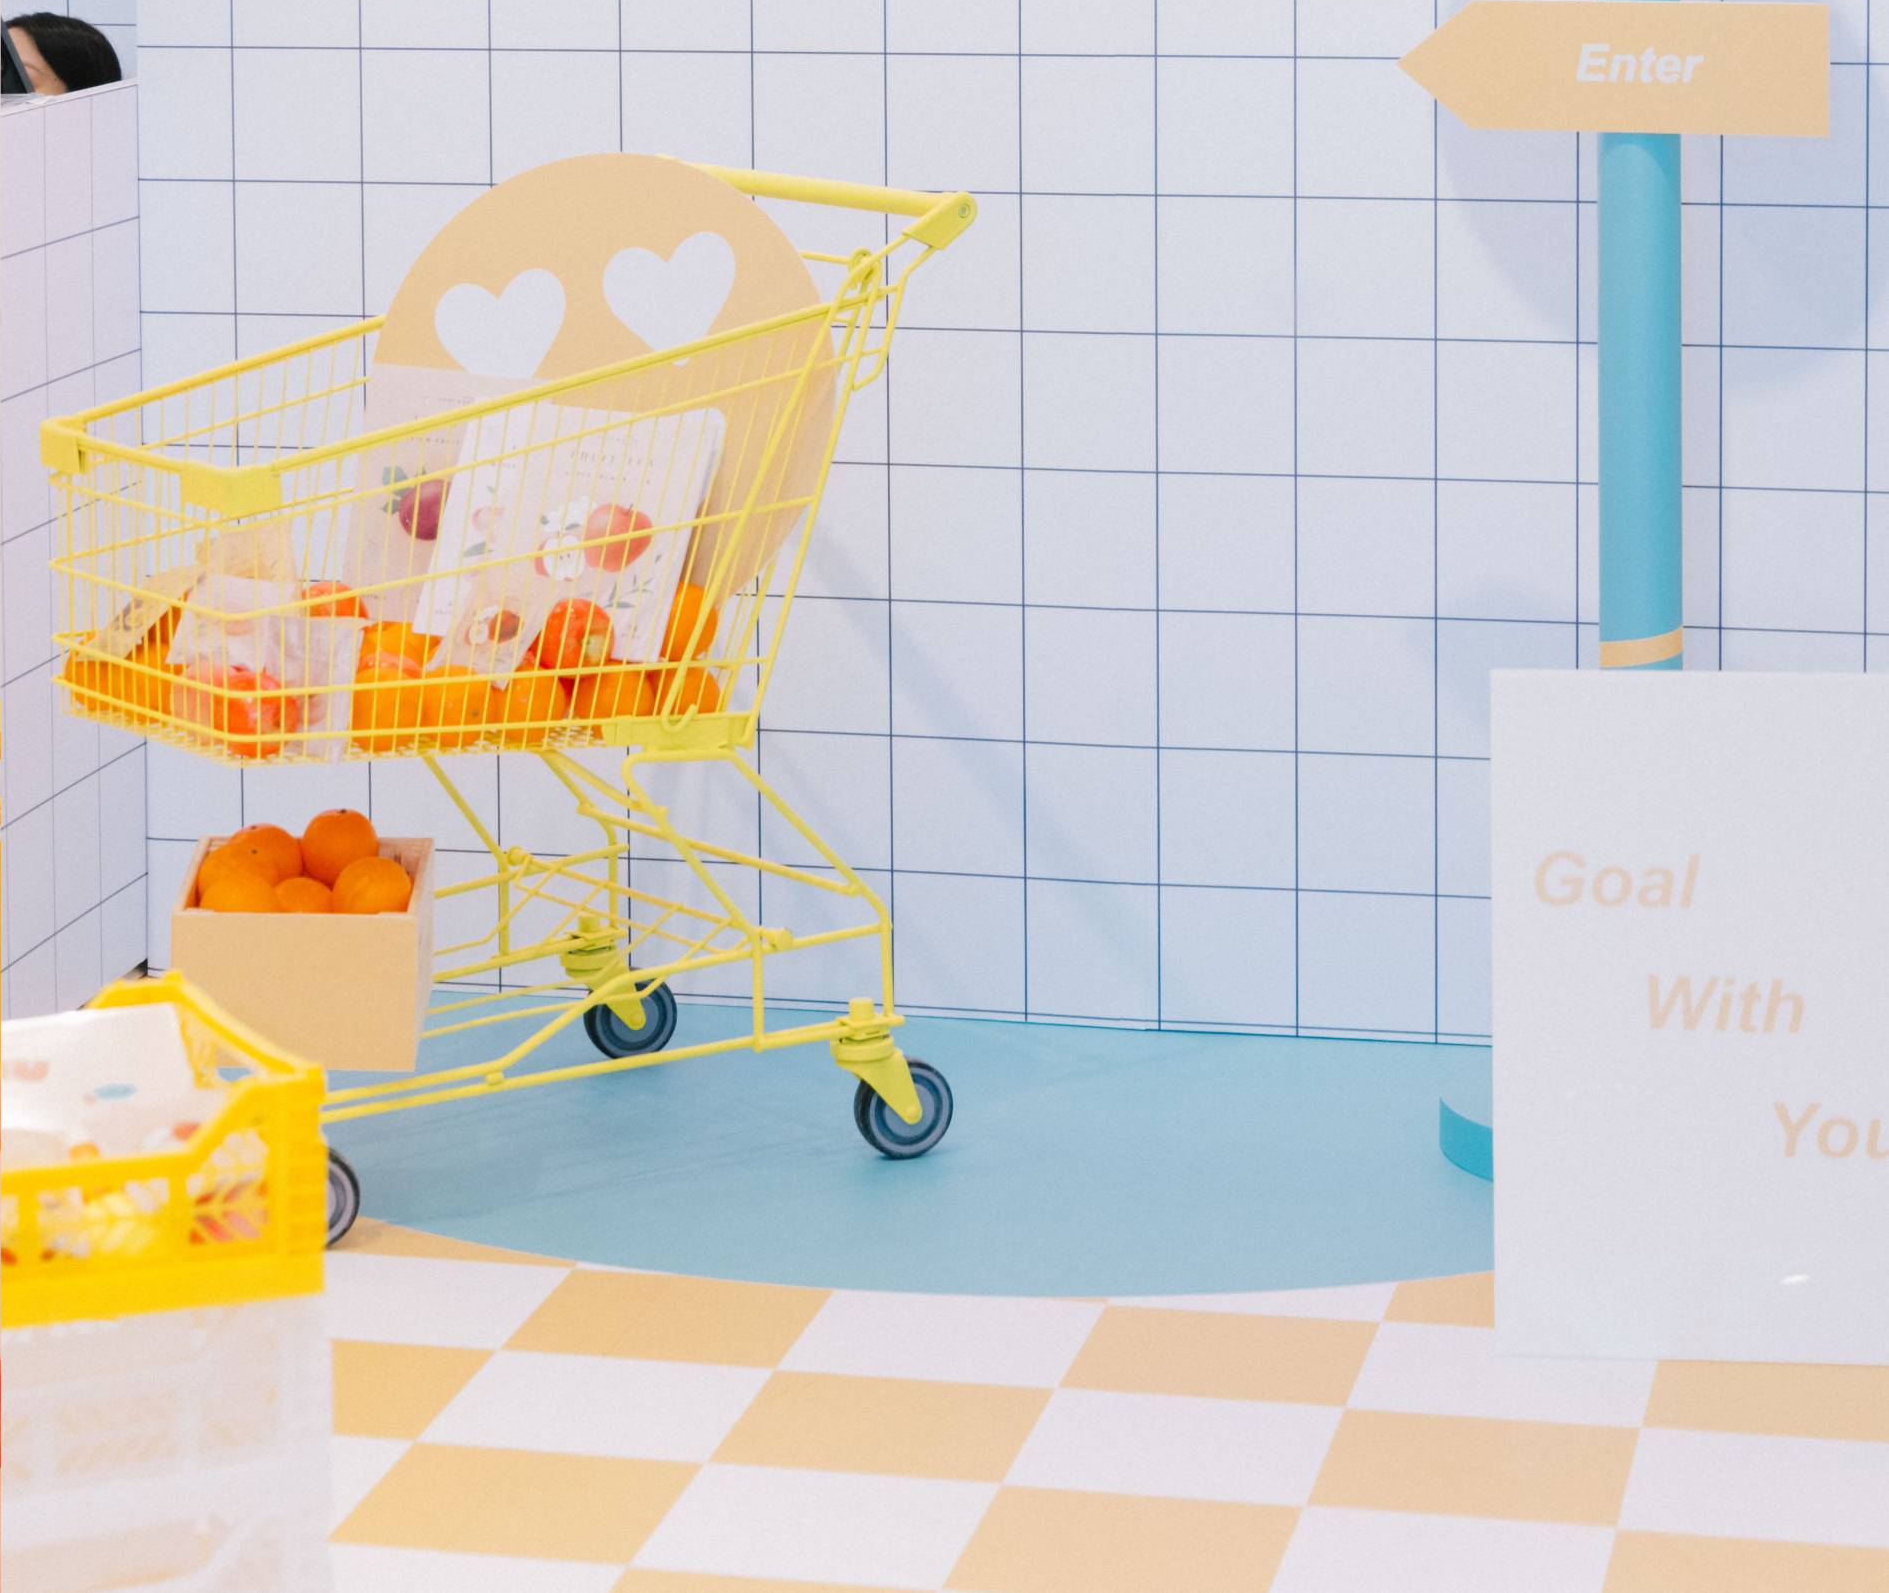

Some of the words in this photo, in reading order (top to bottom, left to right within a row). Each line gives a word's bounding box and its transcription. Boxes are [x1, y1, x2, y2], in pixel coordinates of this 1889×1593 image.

[1575, 43, 1704, 85] Enter
[1533, 850, 1700, 908] Goal
[1647, 974, 1805, 1034] With
